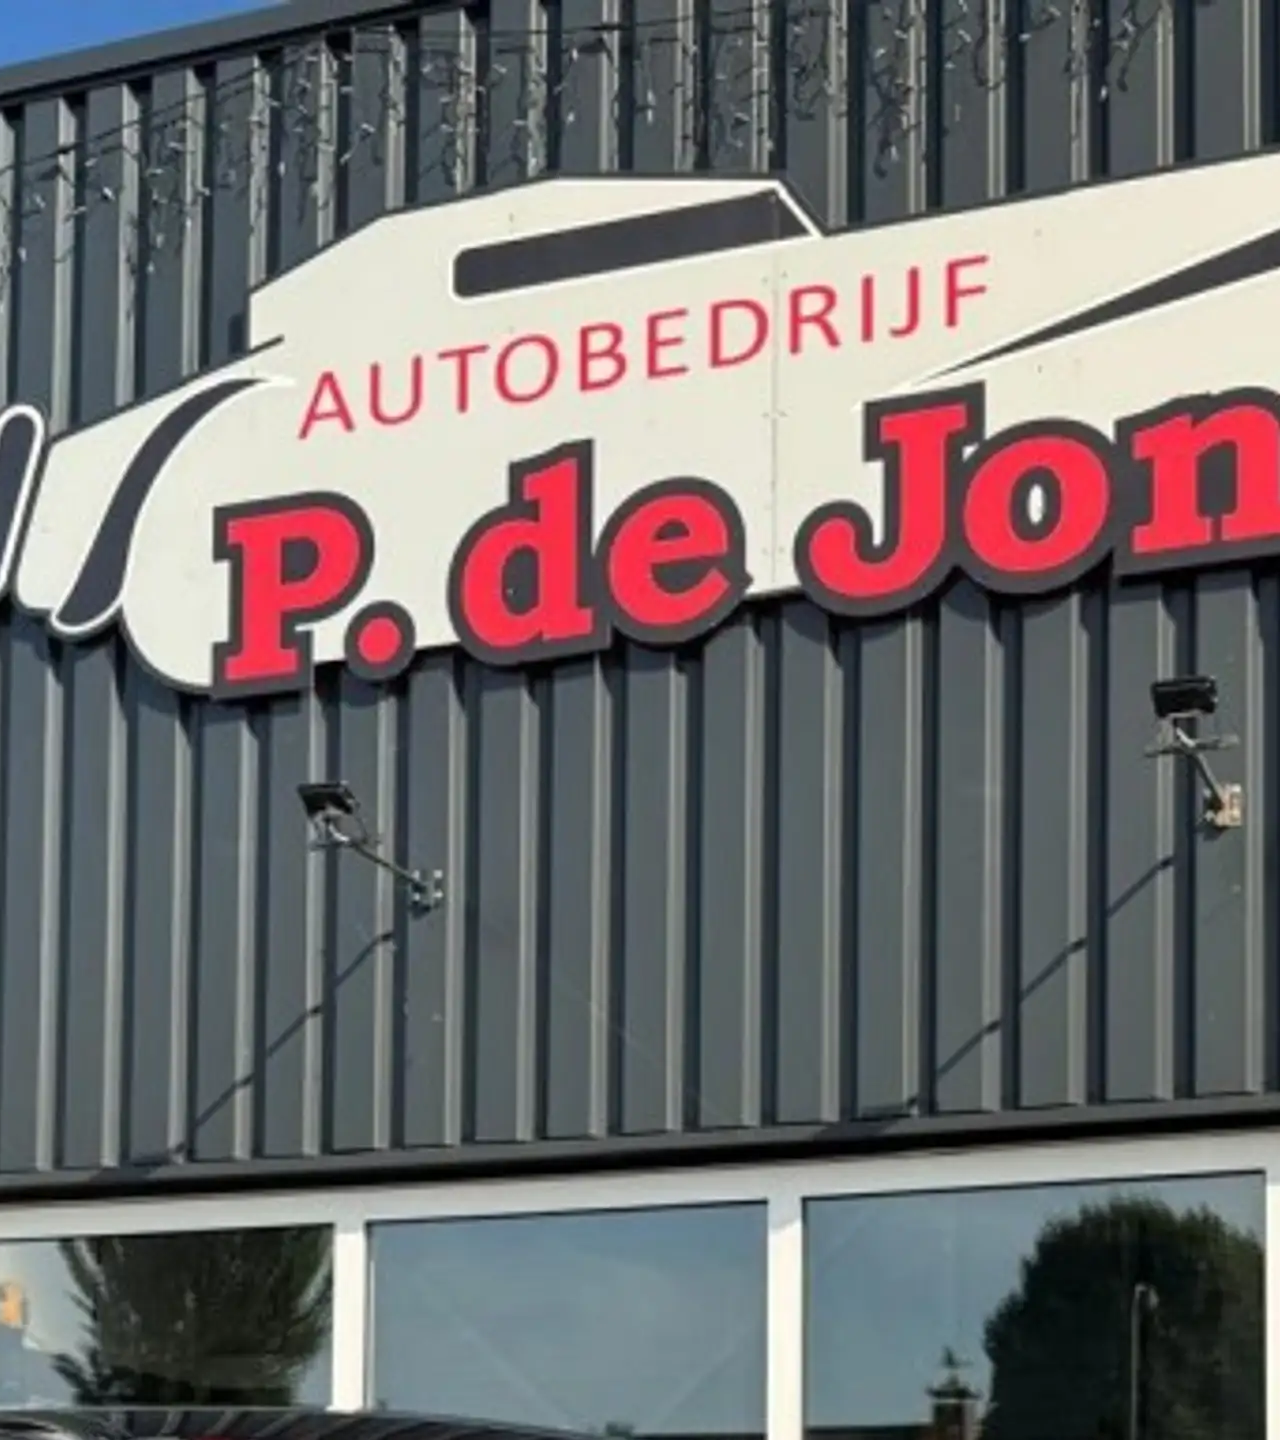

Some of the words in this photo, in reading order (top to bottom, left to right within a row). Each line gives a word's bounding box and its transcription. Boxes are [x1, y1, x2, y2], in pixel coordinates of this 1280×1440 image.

[298, 254, 991, 440] AUTOBEDRIJF
[215, 493, 414, 696] P.
[452, 441, 752, 662] de
